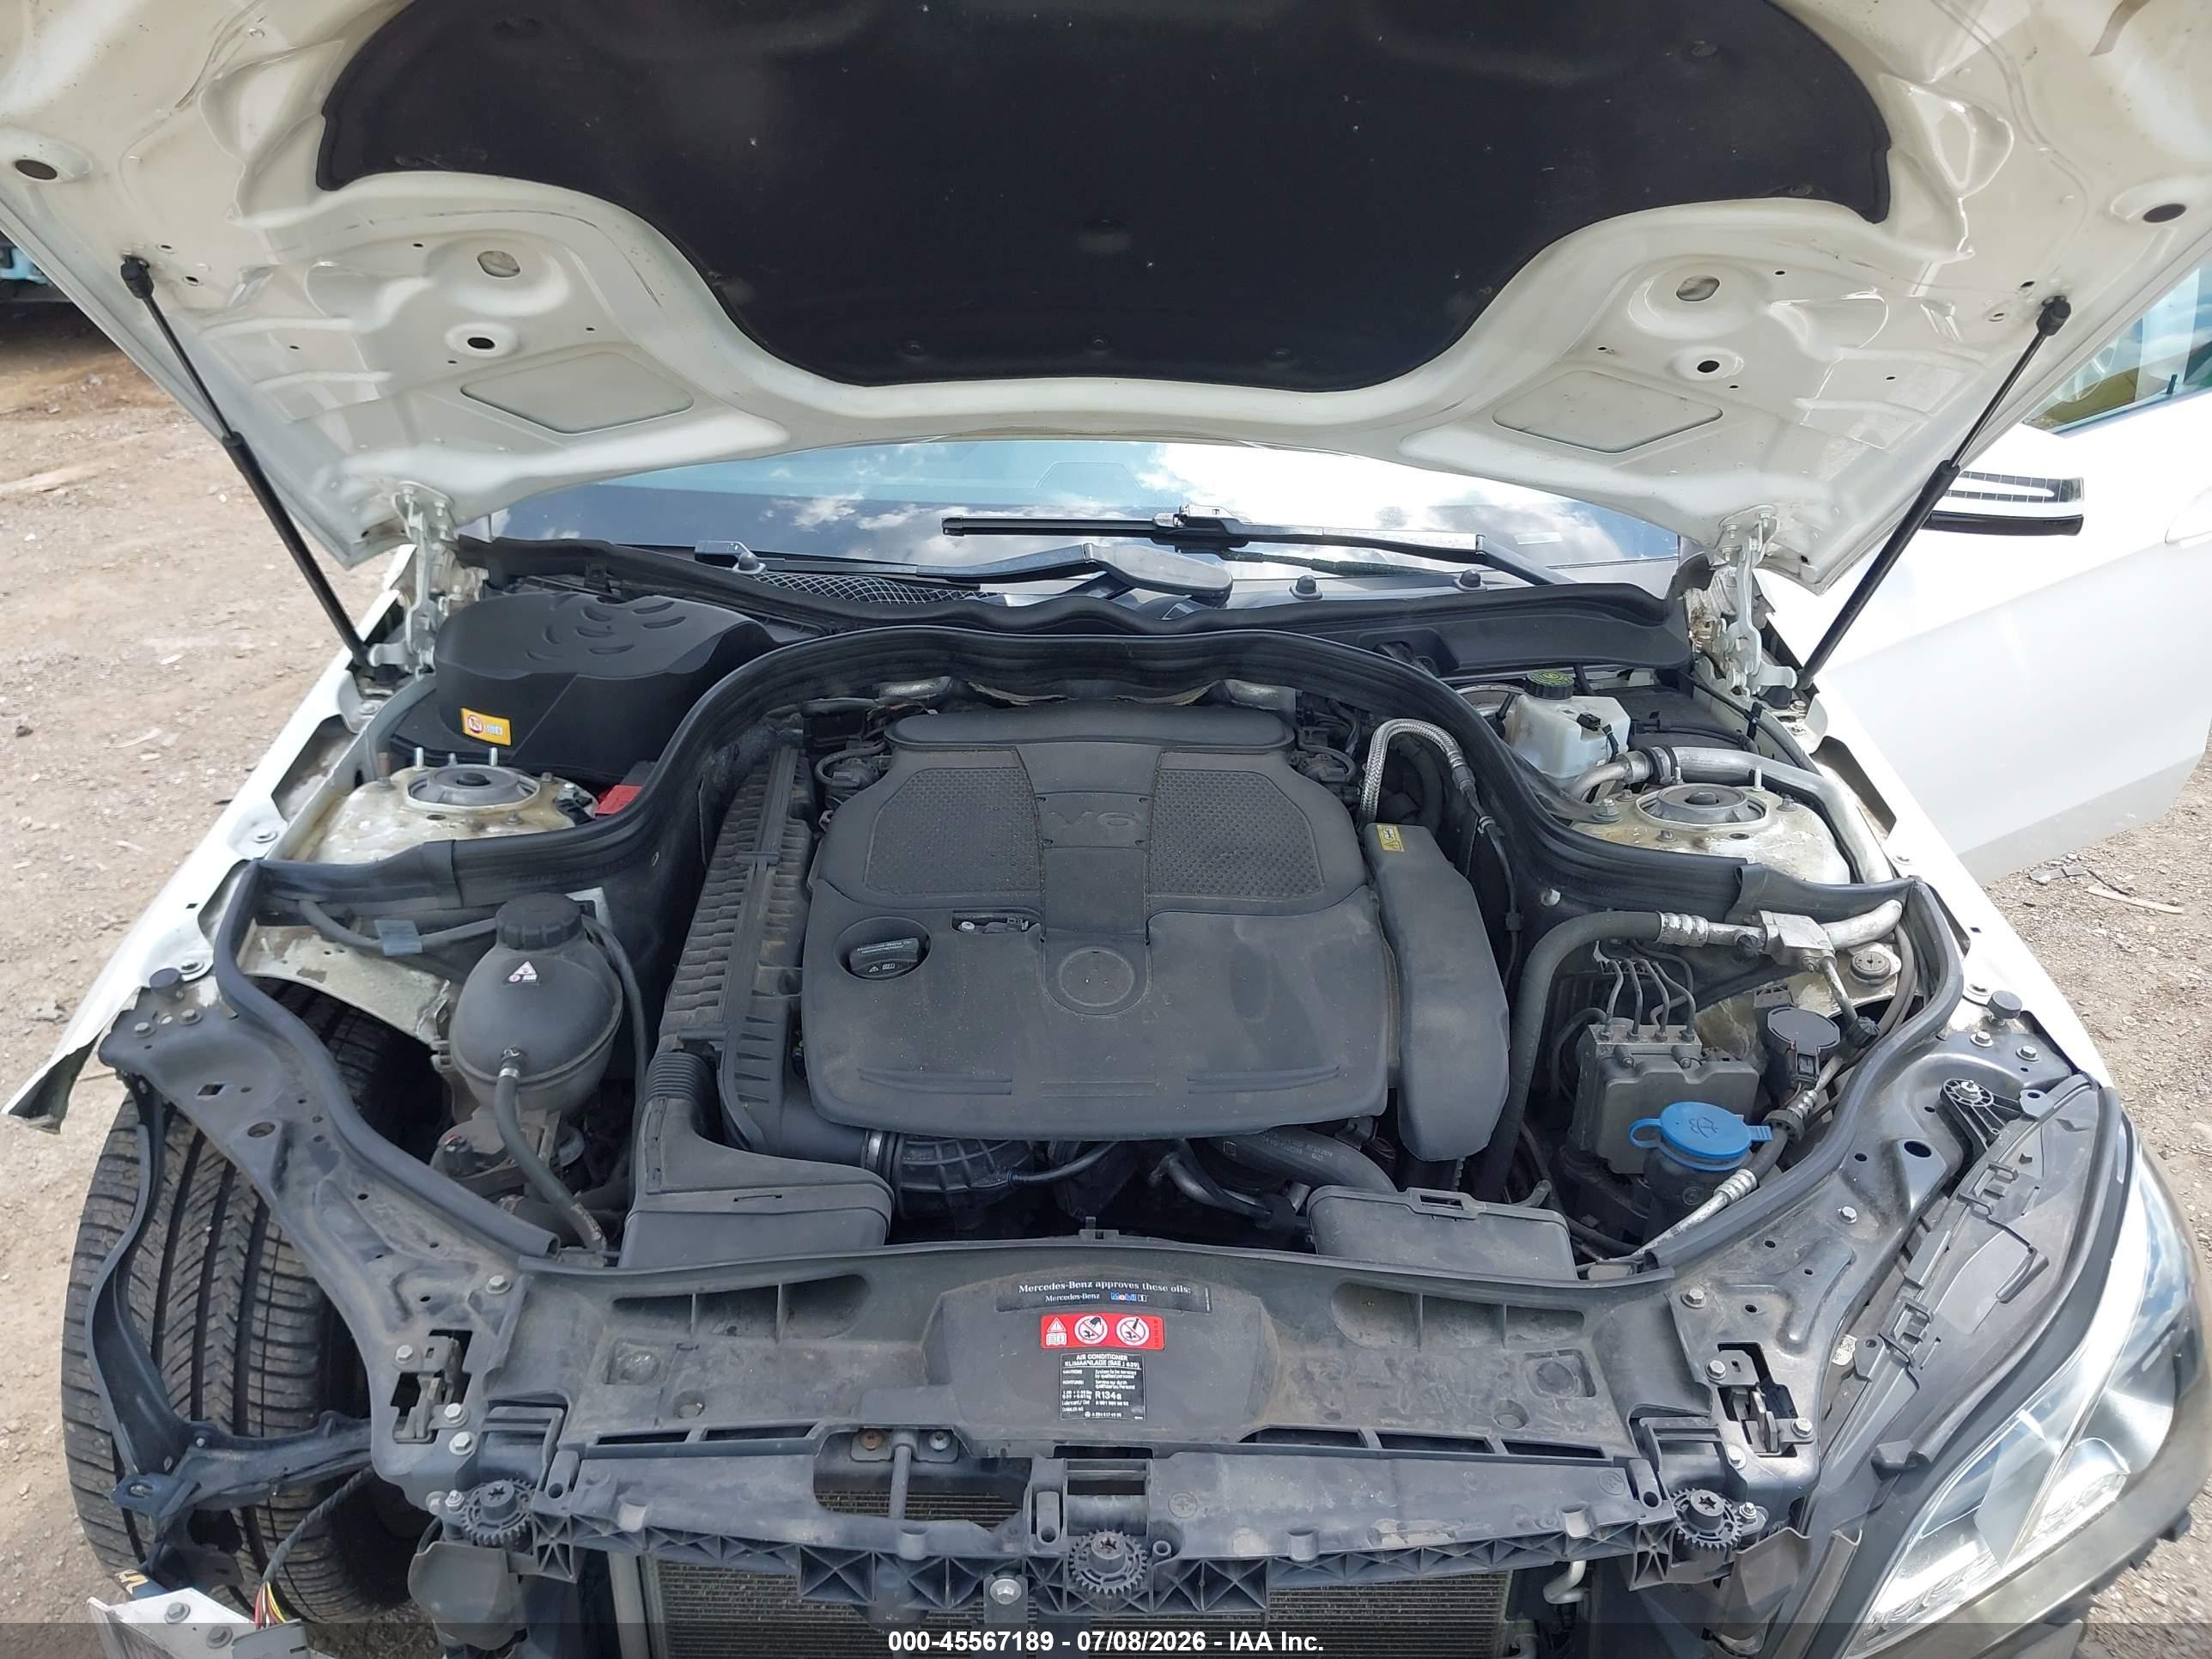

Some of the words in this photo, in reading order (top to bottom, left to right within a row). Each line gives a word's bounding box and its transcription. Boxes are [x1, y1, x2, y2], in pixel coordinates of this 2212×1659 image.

[1018, 1281, 1093, 1293] Mercedes-Benz
[1095, 1281, 1139, 1290] approves
[1142, 1282, 1169, 1291] these
[1045, 1292, 1100, 1303] Mercedes-Benz
